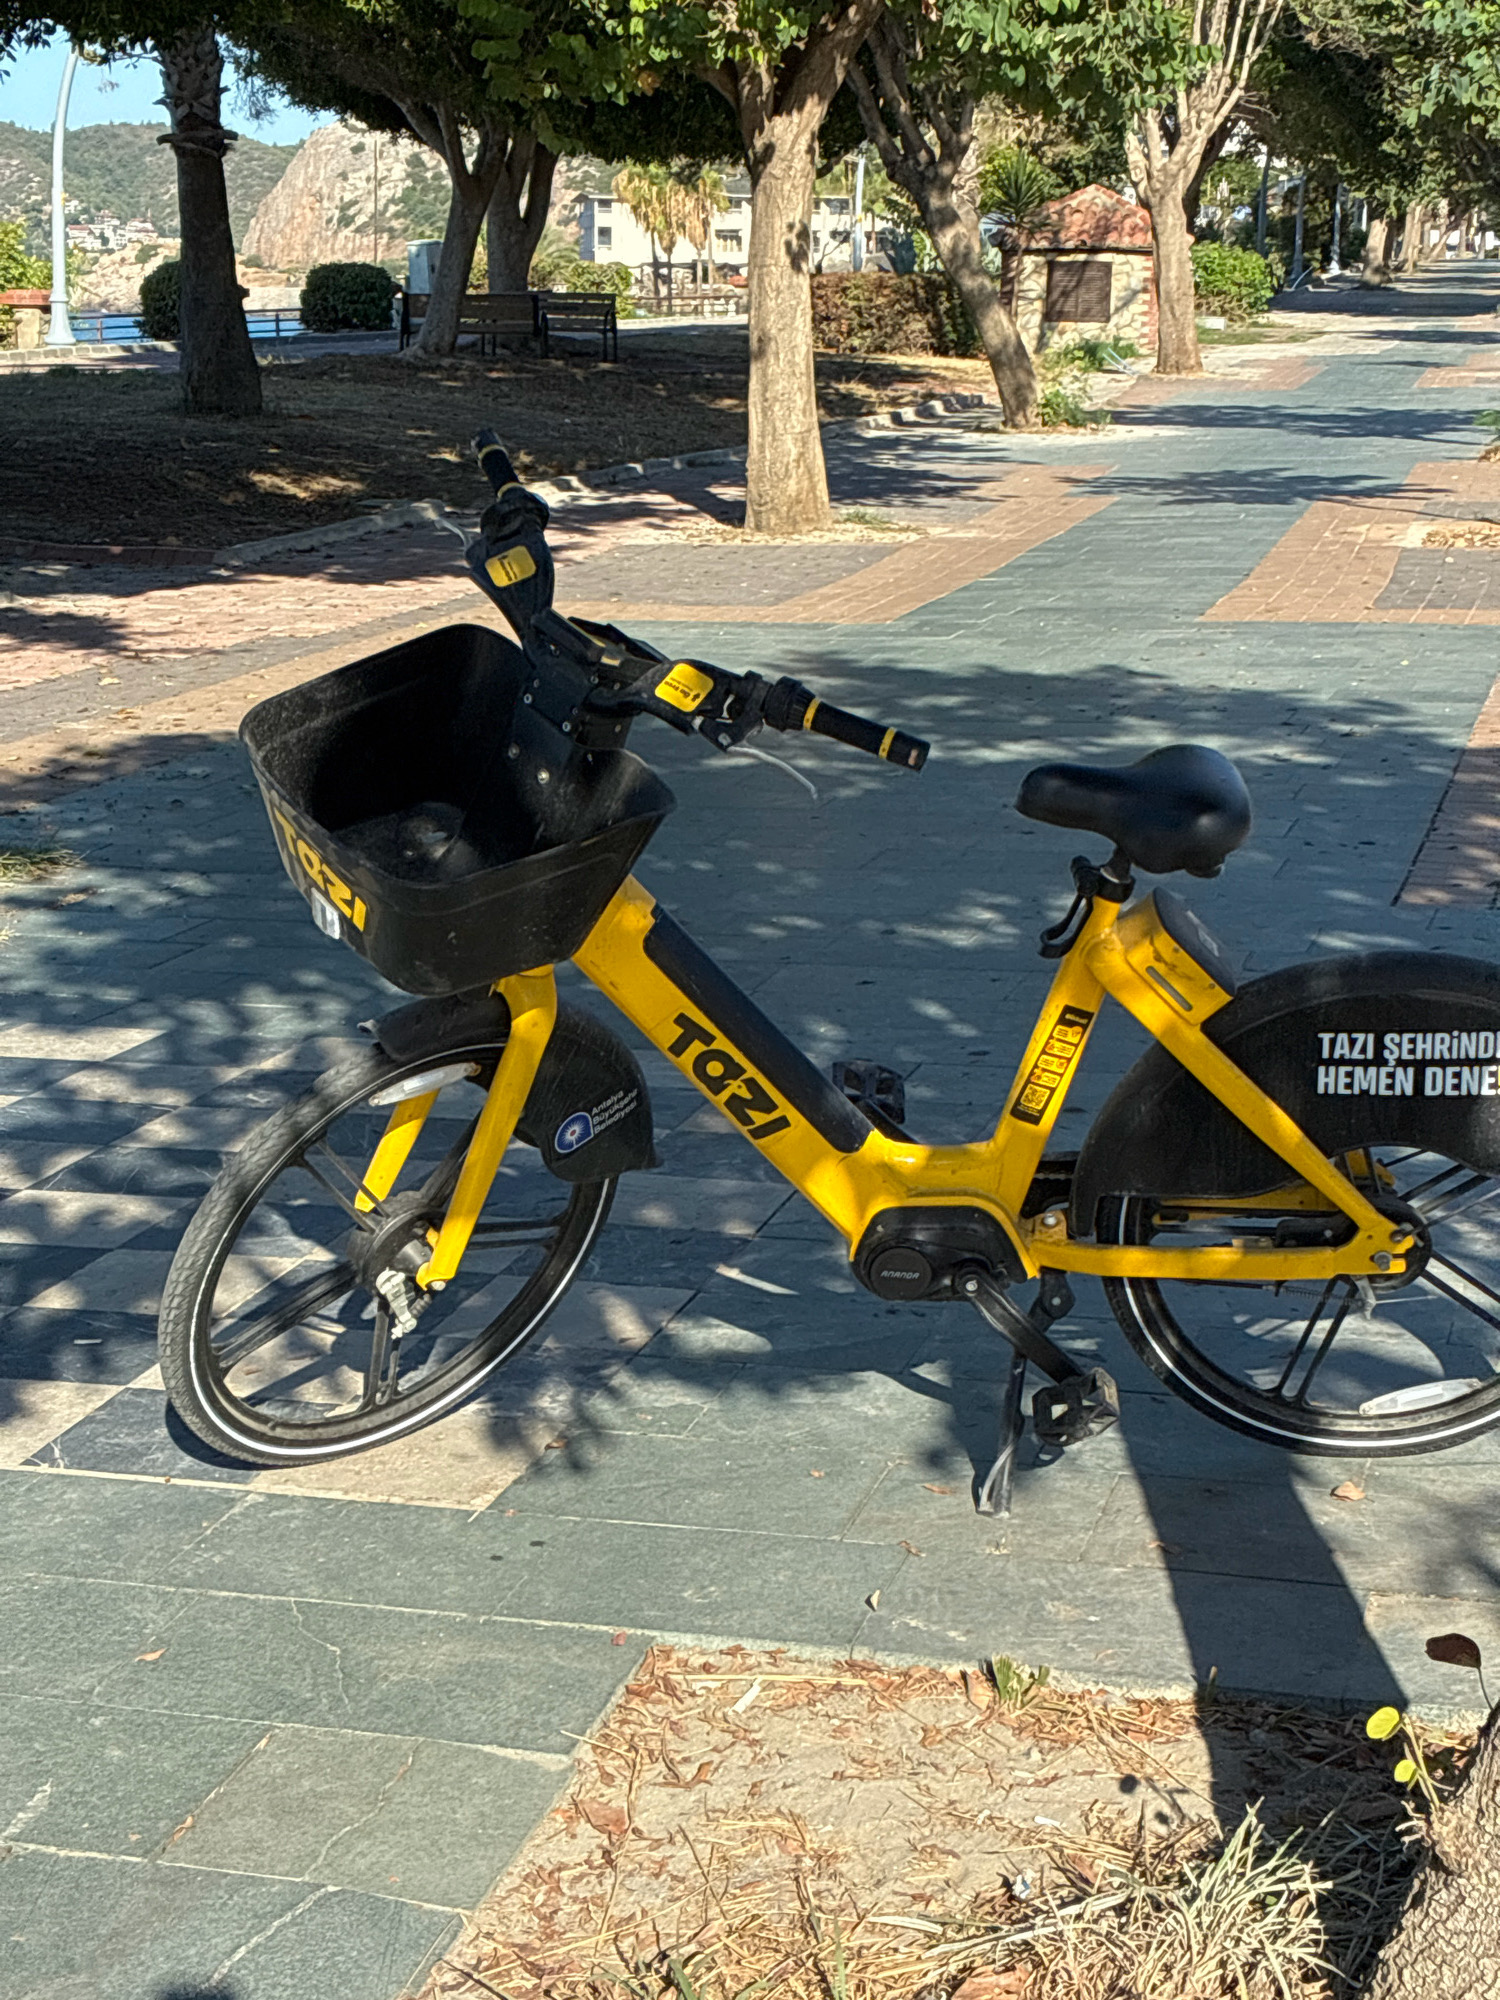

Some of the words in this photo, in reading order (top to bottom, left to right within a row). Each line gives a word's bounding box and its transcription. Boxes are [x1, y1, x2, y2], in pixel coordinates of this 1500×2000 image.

[1317, 1032, 1375, 1060] TAZI
[1382, 1030, 1500, 1066] ŞEHRİND
[1316, 1066, 1415, 1097] HEMEN
[591, 1090, 624, 1116] Antalya
[594, 1100, 638, 1134] Belediyesi
